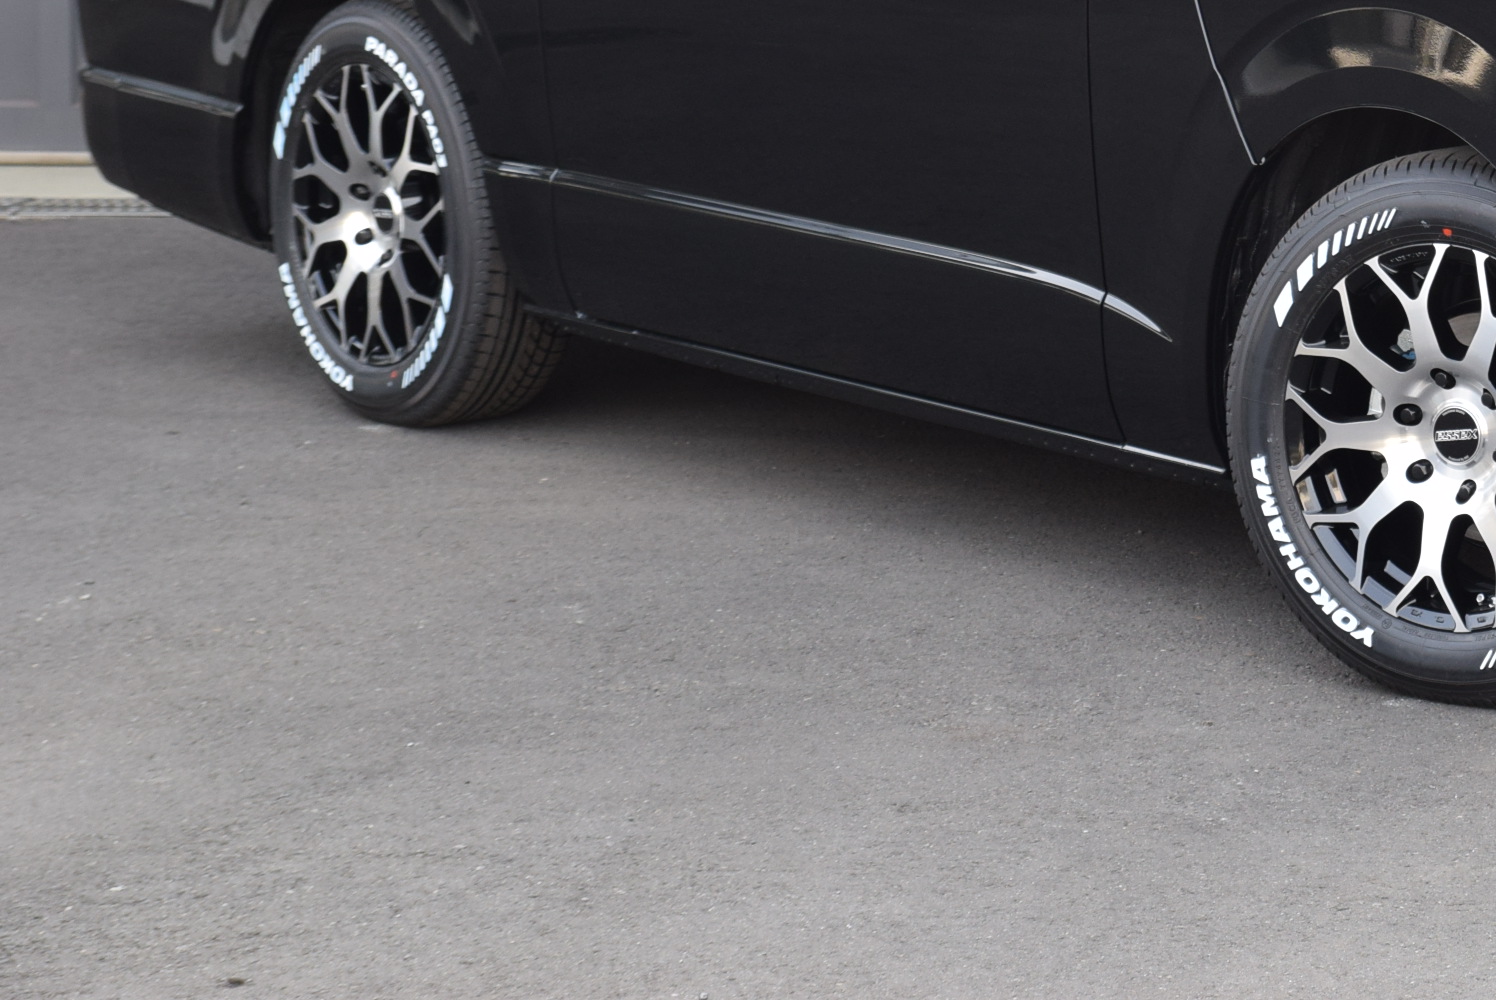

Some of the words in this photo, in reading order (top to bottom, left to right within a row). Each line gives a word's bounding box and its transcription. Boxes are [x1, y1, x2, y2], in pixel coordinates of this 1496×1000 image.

[364, 35, 425, 107] PARADA
[278, 262, 354, 391] YOKOHAMA
[1250, 456, 1375, 648] YOKOHAMA
